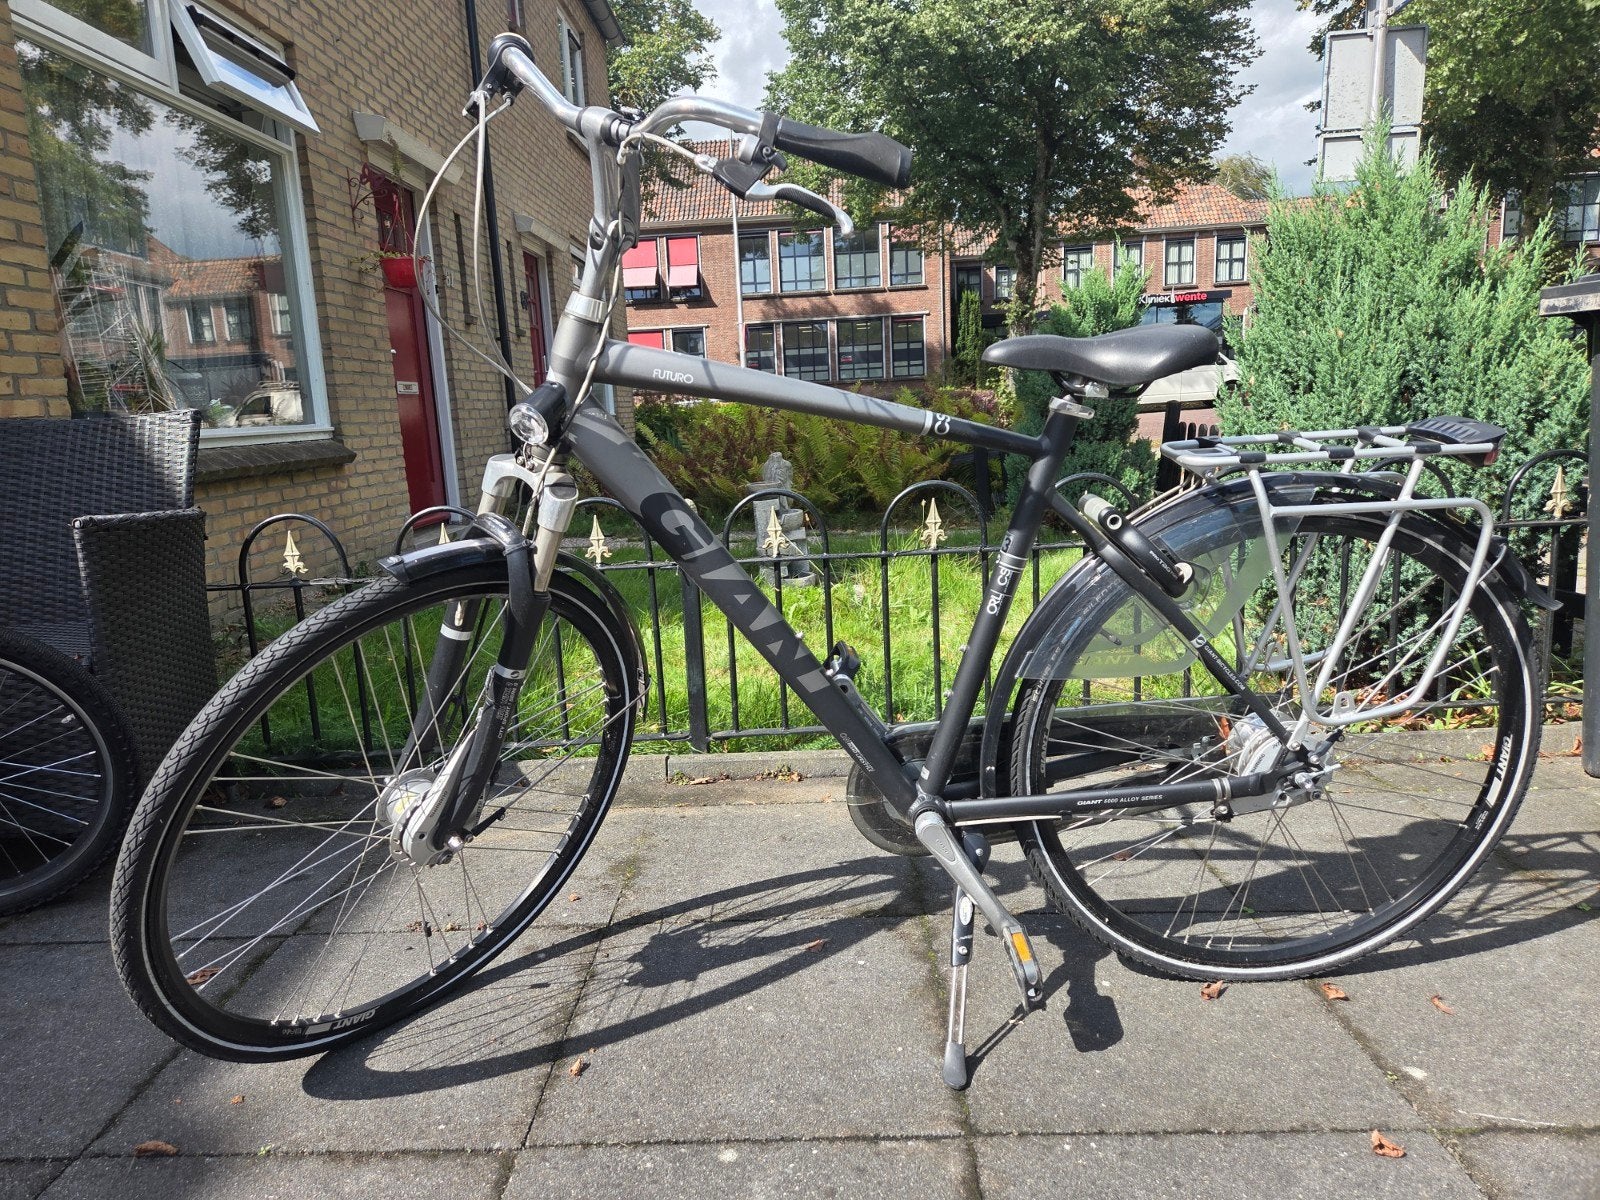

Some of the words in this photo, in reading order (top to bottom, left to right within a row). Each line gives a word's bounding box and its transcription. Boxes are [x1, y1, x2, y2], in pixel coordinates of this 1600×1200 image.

[652, 368, 694, 384] FUTURO
[1496, 735, 1511, 777] GIANT
[333, 1008, 376, 1030] GIANT
